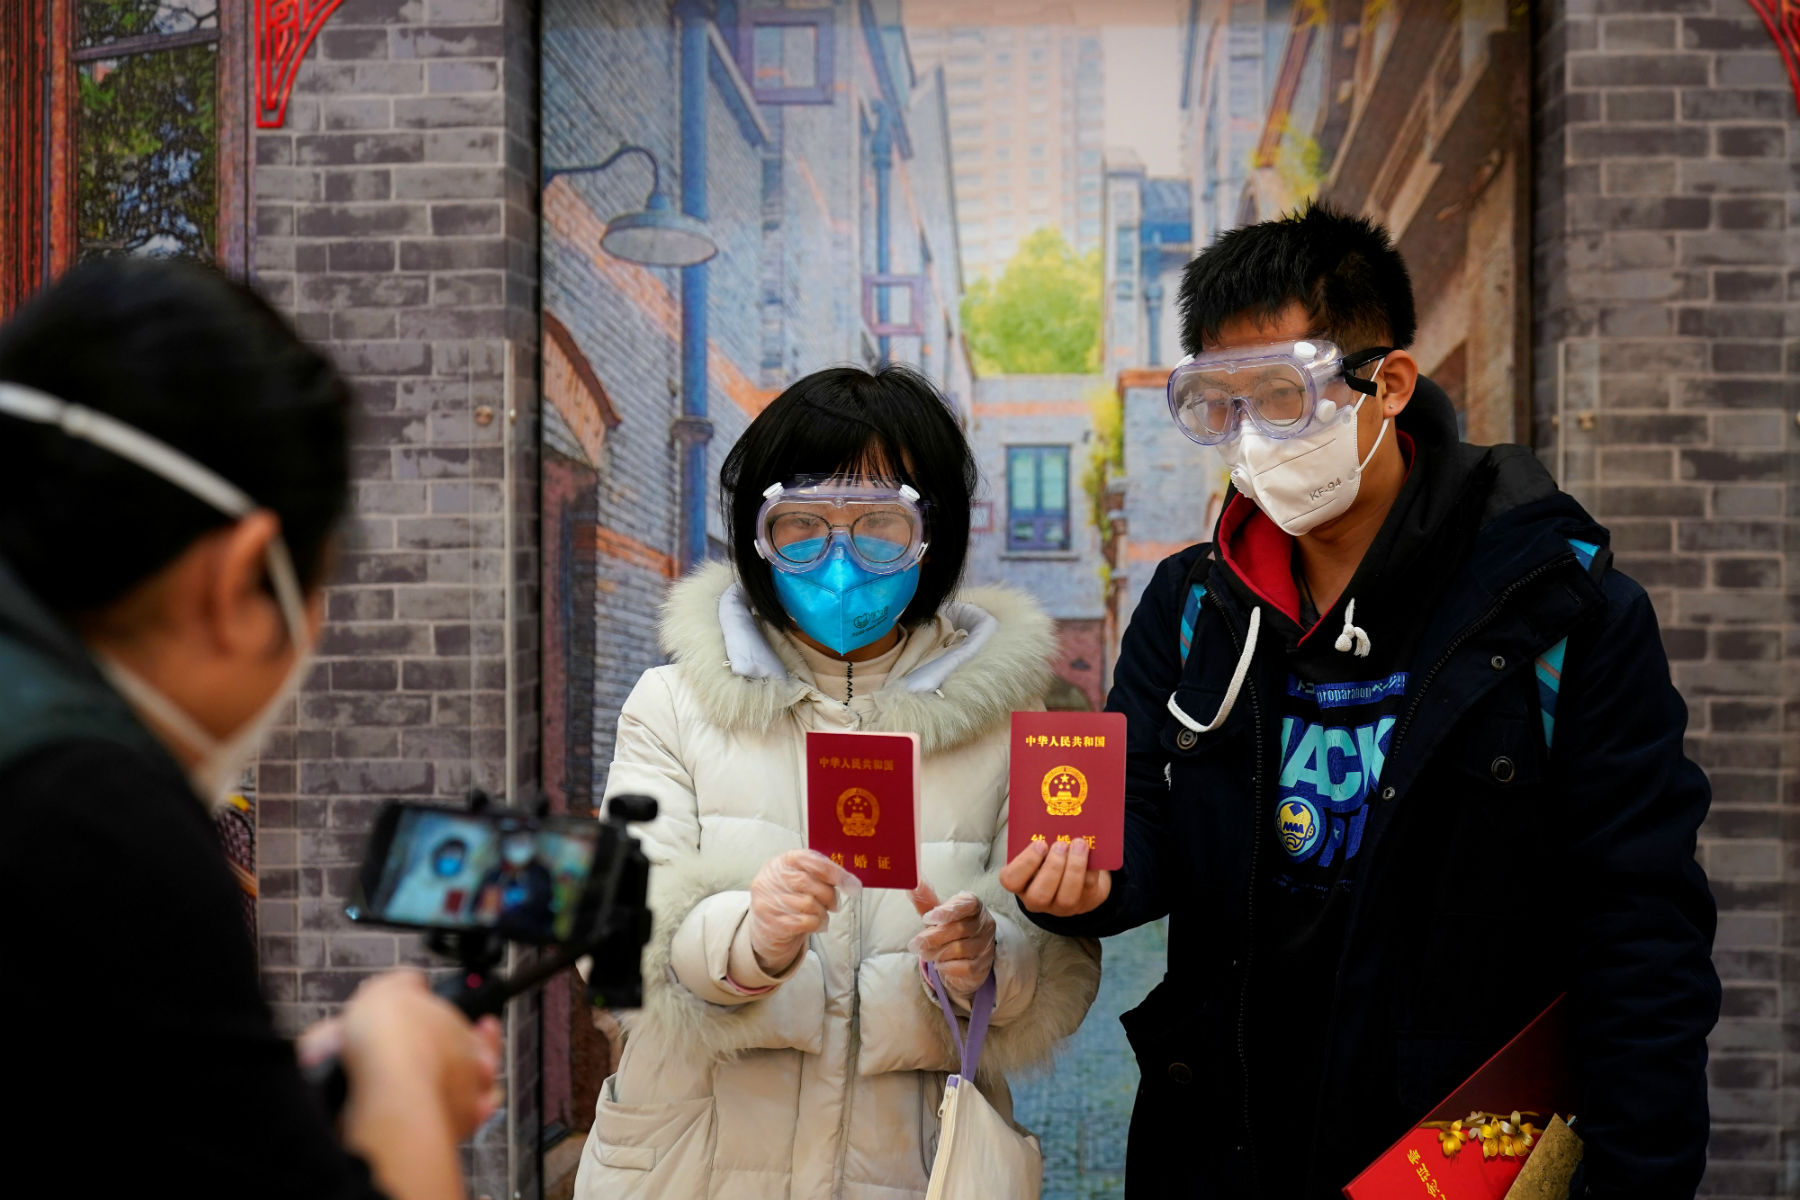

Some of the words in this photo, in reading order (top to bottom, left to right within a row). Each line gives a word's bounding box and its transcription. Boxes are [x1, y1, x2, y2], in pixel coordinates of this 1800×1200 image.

[1310, 477, 1342, 500] KF-94
[1025, 735, 1106, 748] 中华人民共和国
[819, 756, 894, 771] 中华人民共和国
[830, 852, 891, 870] 结婚证
[1407, 1149, 1446, 1200] 念证套
